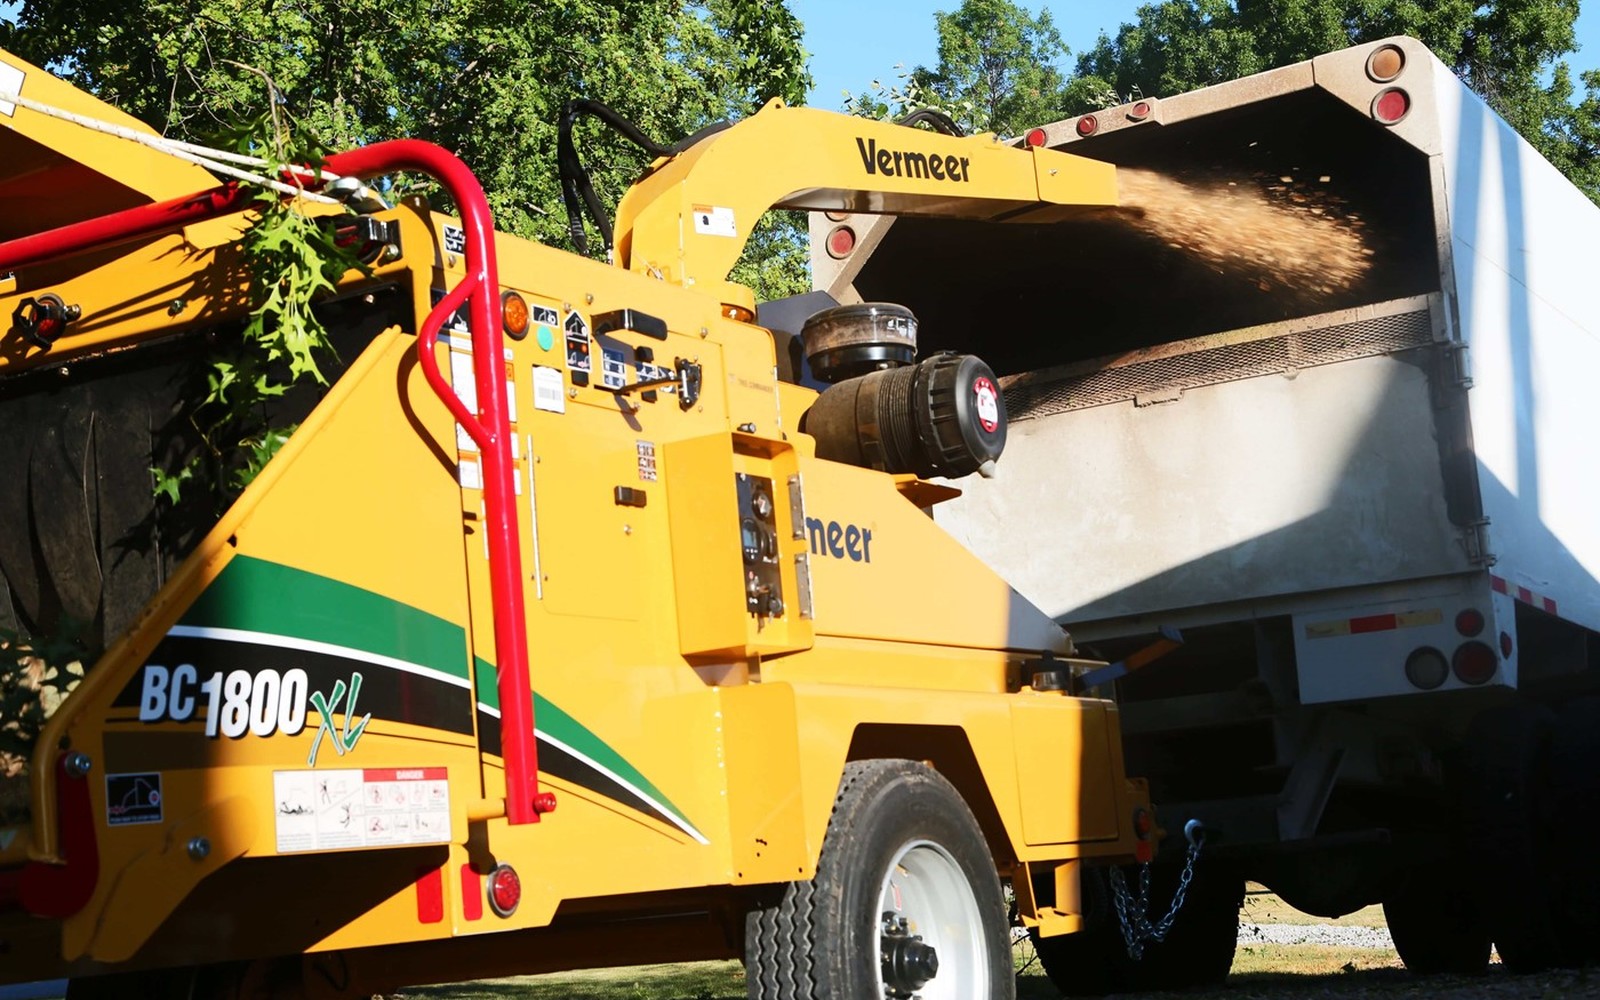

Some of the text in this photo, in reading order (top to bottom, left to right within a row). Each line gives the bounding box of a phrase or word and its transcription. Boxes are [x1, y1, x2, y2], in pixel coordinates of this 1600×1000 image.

[855, 137, 969, 182] Vermeer
[805, 516, 872, 563] meer
[309, 672, 371, 767] XL
